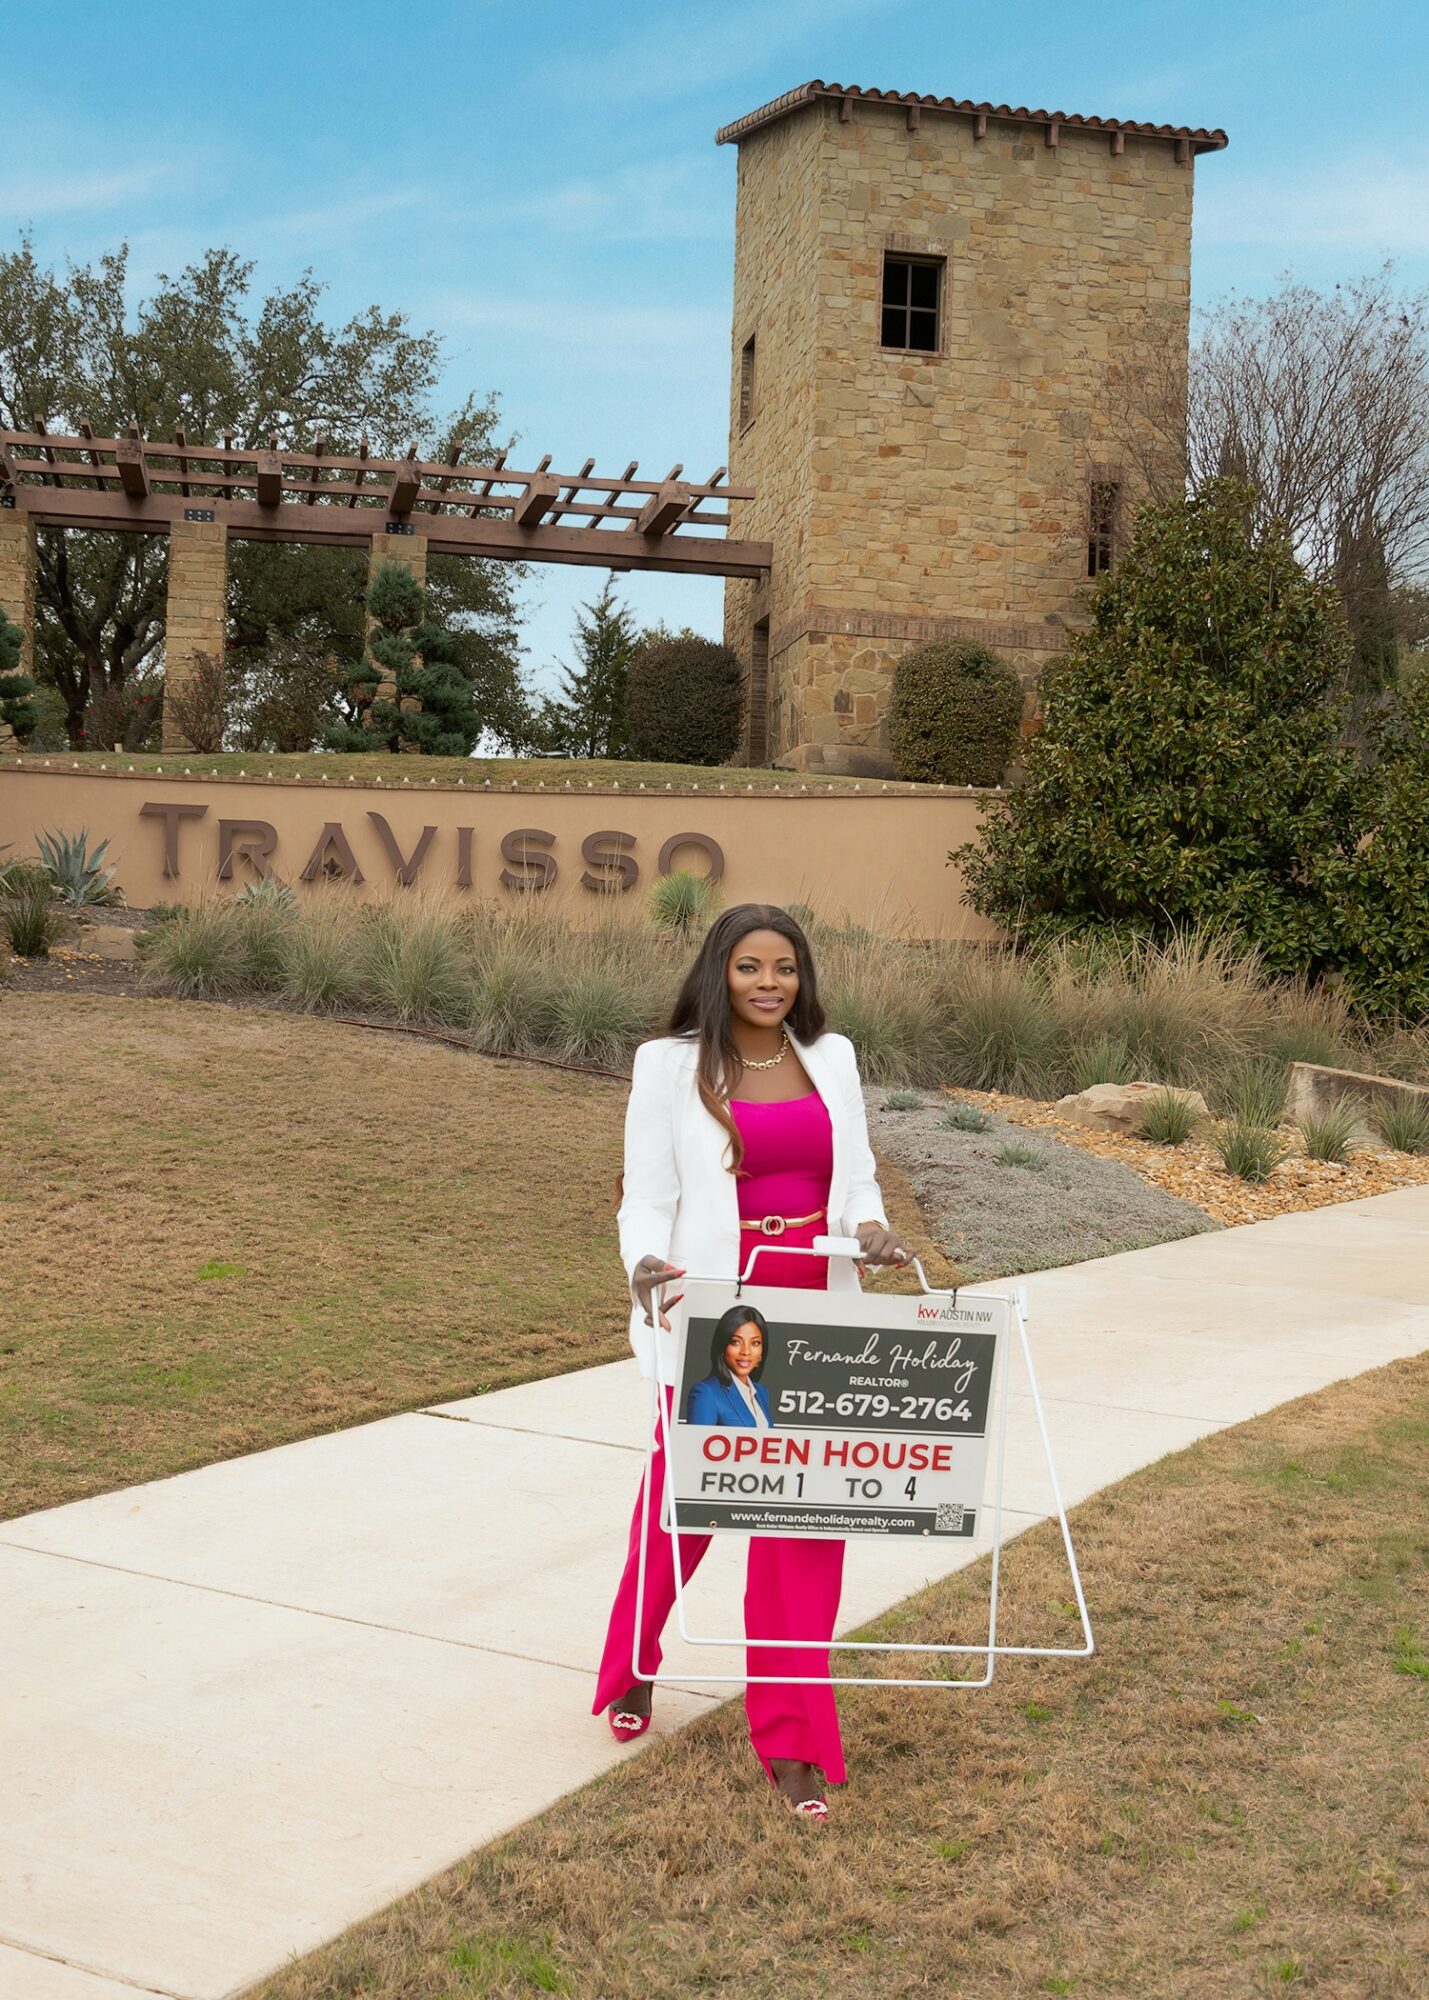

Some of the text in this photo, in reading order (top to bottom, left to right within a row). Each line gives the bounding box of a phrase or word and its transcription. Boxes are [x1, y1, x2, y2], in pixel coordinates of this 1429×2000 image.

[138, 801, 726, 892] TRAVISSO
[917, 1303, 993, 1322] kw AUSTIN NW
[786, 1332, 978, 1394] Fernande Holiday
[778, 1389, 973, 1422] 512-679-2764
[702, 1434, 953, 1472] OPEN HOUSE
[700, 1471, 917, 1502] FROM 1 TO 4
[730, 1510, 915, 1528] www.fernandeholidayrealty.com
